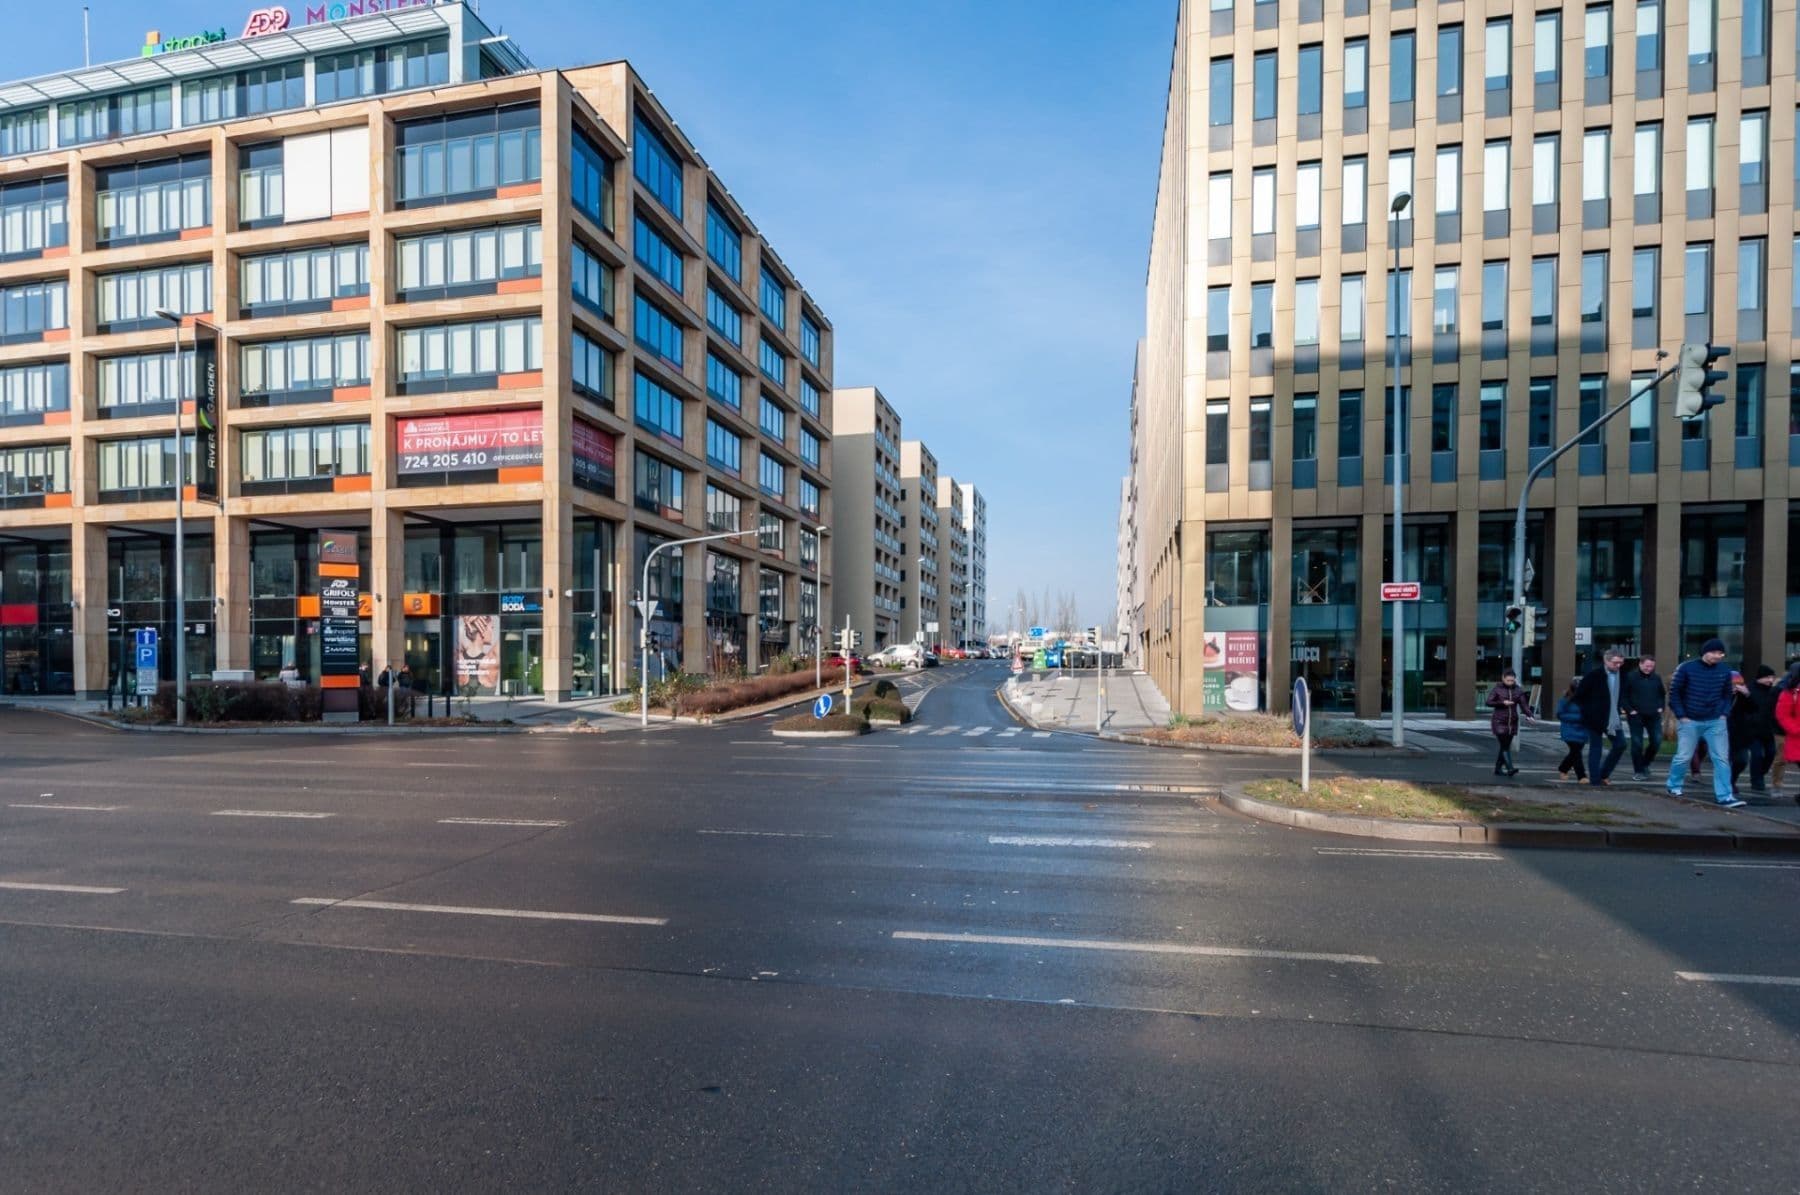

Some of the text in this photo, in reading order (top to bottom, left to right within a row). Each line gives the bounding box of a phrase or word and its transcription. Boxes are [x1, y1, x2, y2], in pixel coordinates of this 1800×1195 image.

[306, 0, 427, 25] MONS
[242, 7, 288, 38] ADP
[404, 438, 412, 449] K
[416, 432, 487, 448] PRONÁJMU
[502, 431, 519, 444] TO
[523, 430, 543, 442] LET
[207, 434, 216, 469] RIVER
[404, 455, 429, 469] 724
[433, 453, 459, 467] 205
[462, 452, 487, 465] 410
[323, 589, 356, 597] GRIFOLS
[140, 648, 152, 661] P
